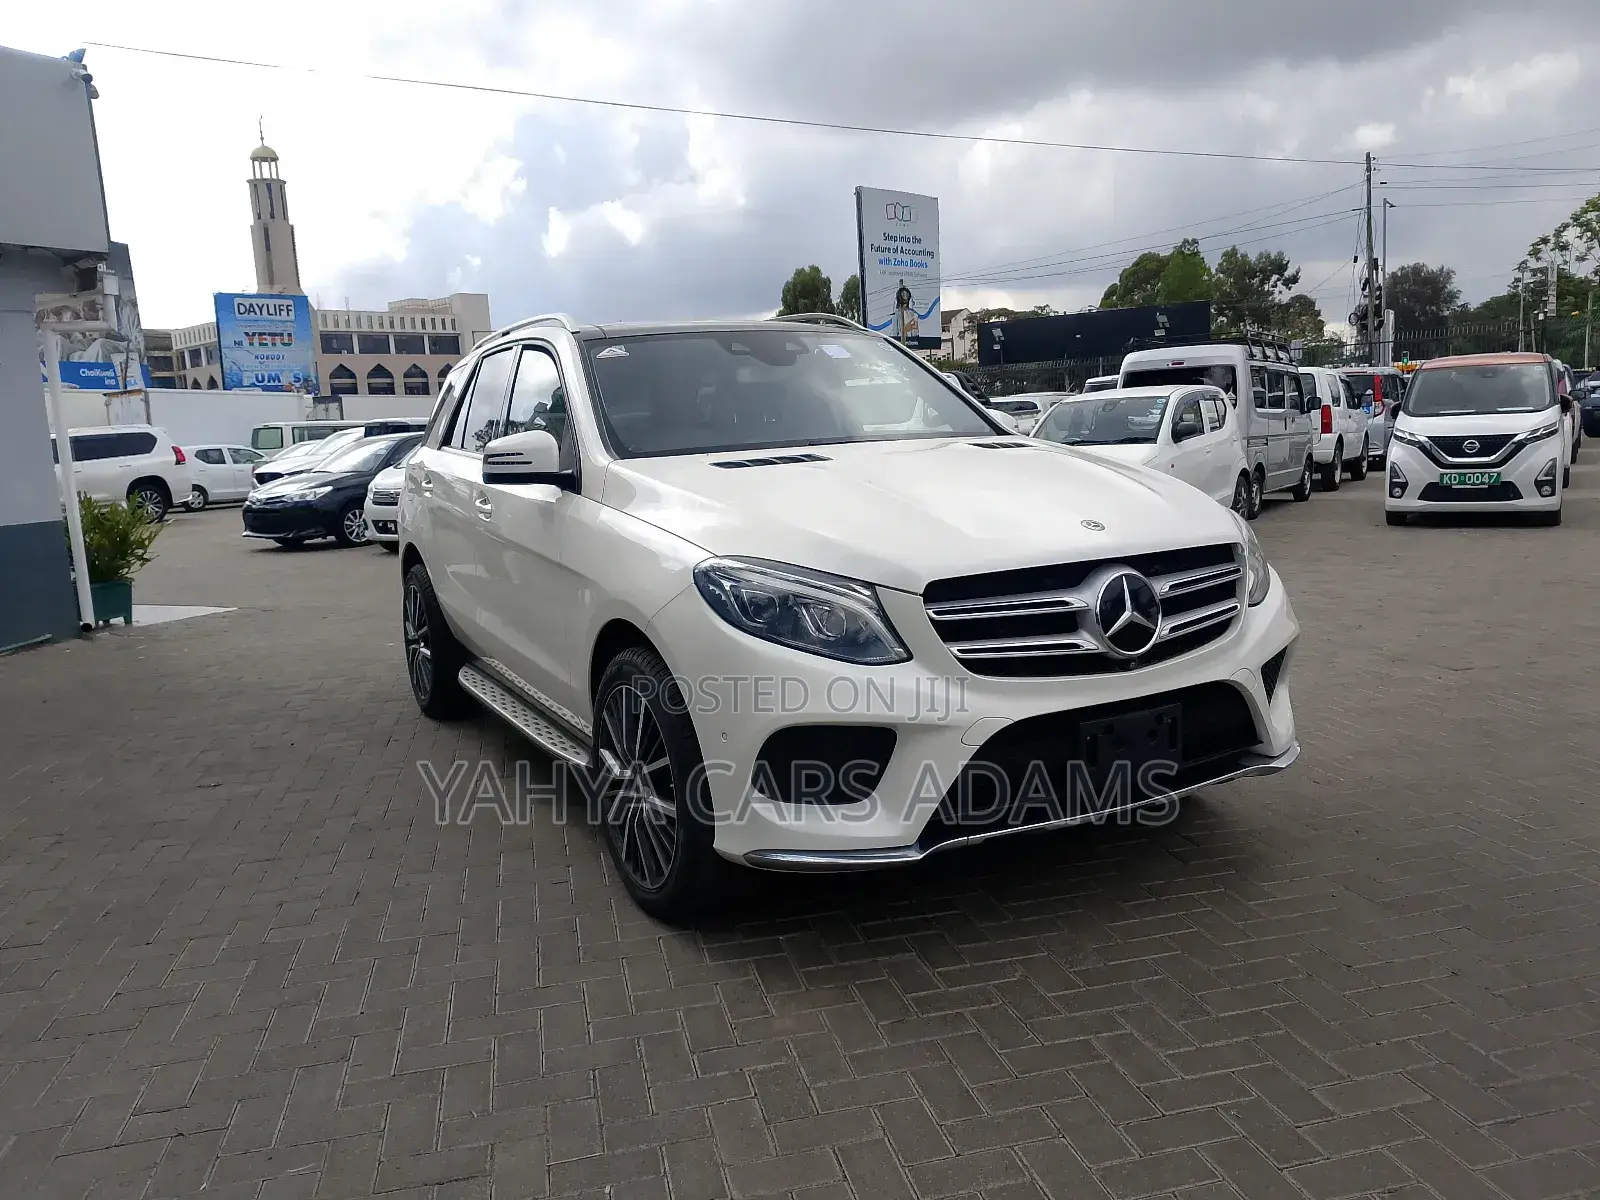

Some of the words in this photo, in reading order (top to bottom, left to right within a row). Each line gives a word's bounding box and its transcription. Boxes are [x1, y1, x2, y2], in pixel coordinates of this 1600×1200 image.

[882, 232, 898, 244] Step
[898, 234, 911, 244] into
[912, 235, 922, 244] the
[870, 243, 892, 255] Future
[892, 245, 899, 255] of
[900, 246, 935, 259] Accounting
[878, 256, 892, 267] with
[893, 257, 908, 268] Zoho
[909, 258, 928, 269] Books
[237, 302, 293, 317] DAYLIFF
[233, 339, 244, 347] NI
[243, 331, 294, 347] YETU
[254, 353, 286, 361] NOBODY
[1443, 473, 1459, 484] KD
[1465, 472, 1498, 484] 0047
